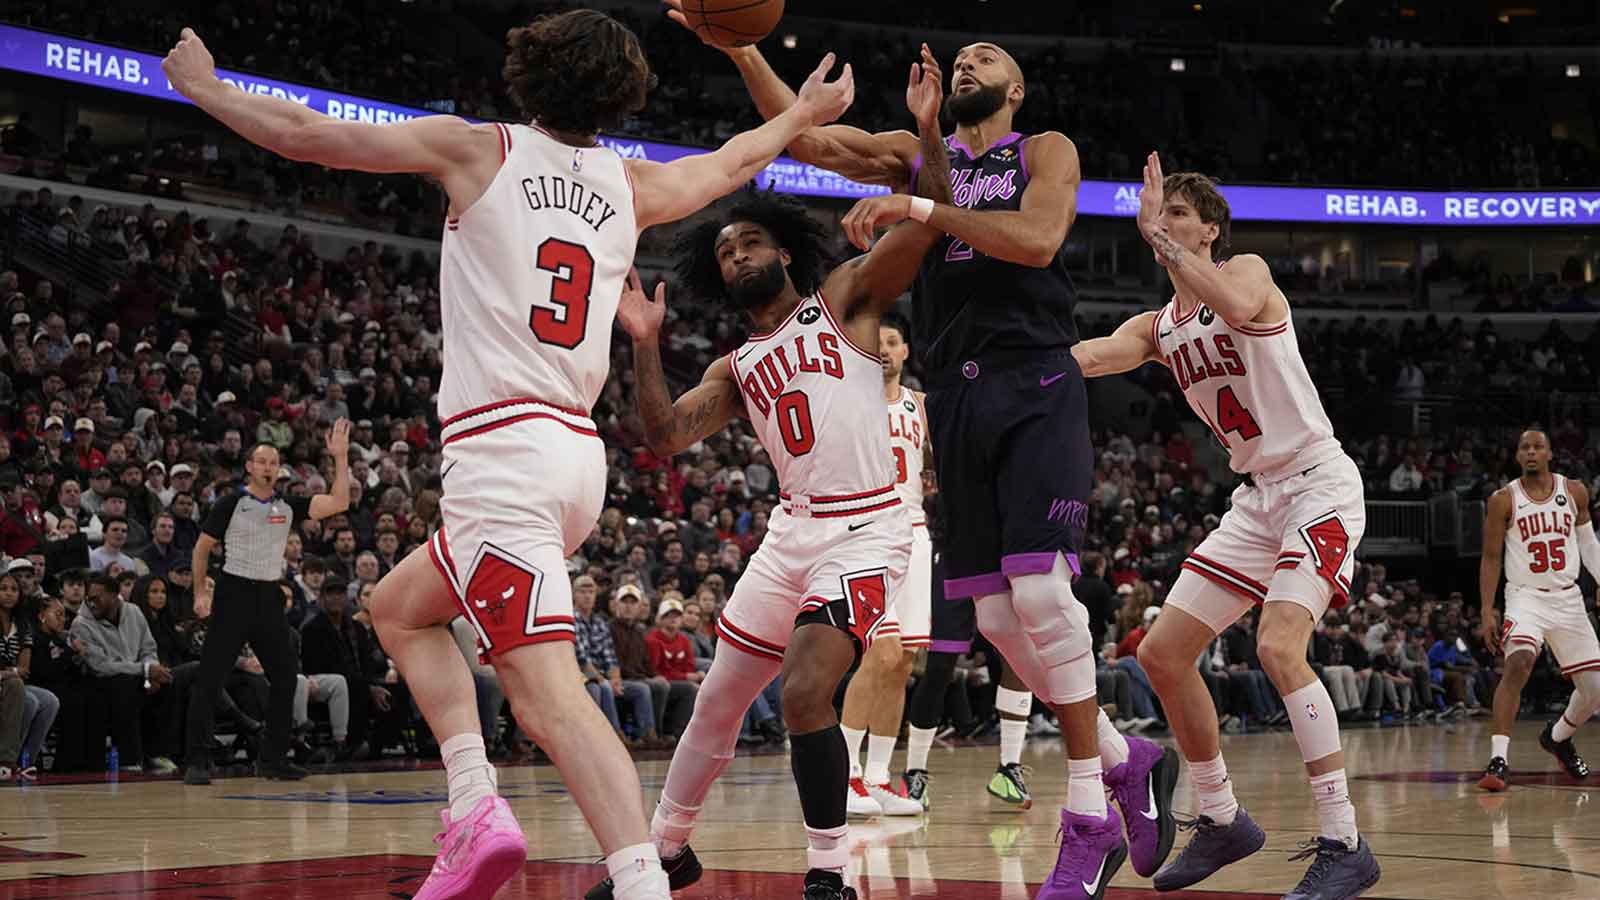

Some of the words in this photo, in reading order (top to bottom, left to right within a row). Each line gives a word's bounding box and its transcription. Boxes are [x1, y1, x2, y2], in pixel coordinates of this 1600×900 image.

[46, 42, 149, 85] REHAB.
[522, 175, 616, 232] GIDDEY
[1326, 194, 1426, 217] REHAB.
[529, 236, 594, 350] 3
[743, 331, 845, 420] BULLS
[1168, 334, 1247, 391] ULLS
[775, 389, 816, 458] 0
[888, 413, 921, 449] LLS
[1517, 511, 1572, 543] BULLS
[1527, 538, 1567, 574] 35
